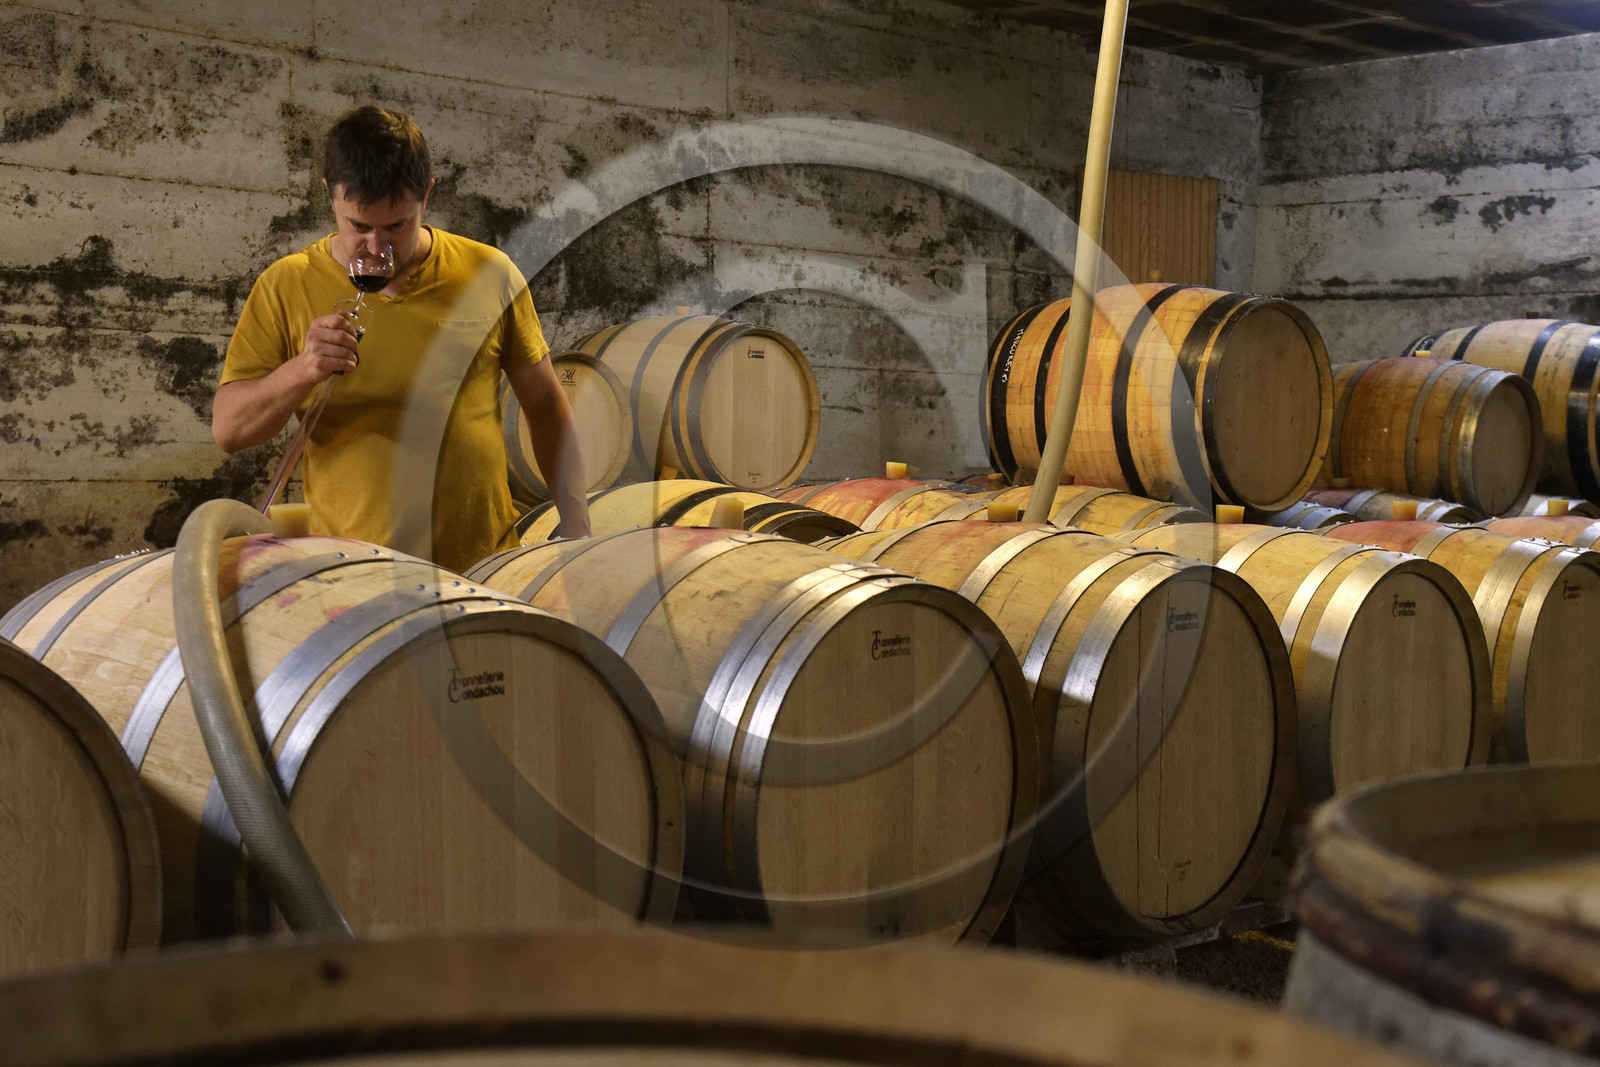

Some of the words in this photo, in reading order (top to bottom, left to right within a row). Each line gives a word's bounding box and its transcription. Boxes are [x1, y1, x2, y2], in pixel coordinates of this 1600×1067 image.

[872, 631, 911, 650] Tonnellerie
[448, 668, 504, 691] Tonnellerie
[448, 678, 505, 704] Condachou
